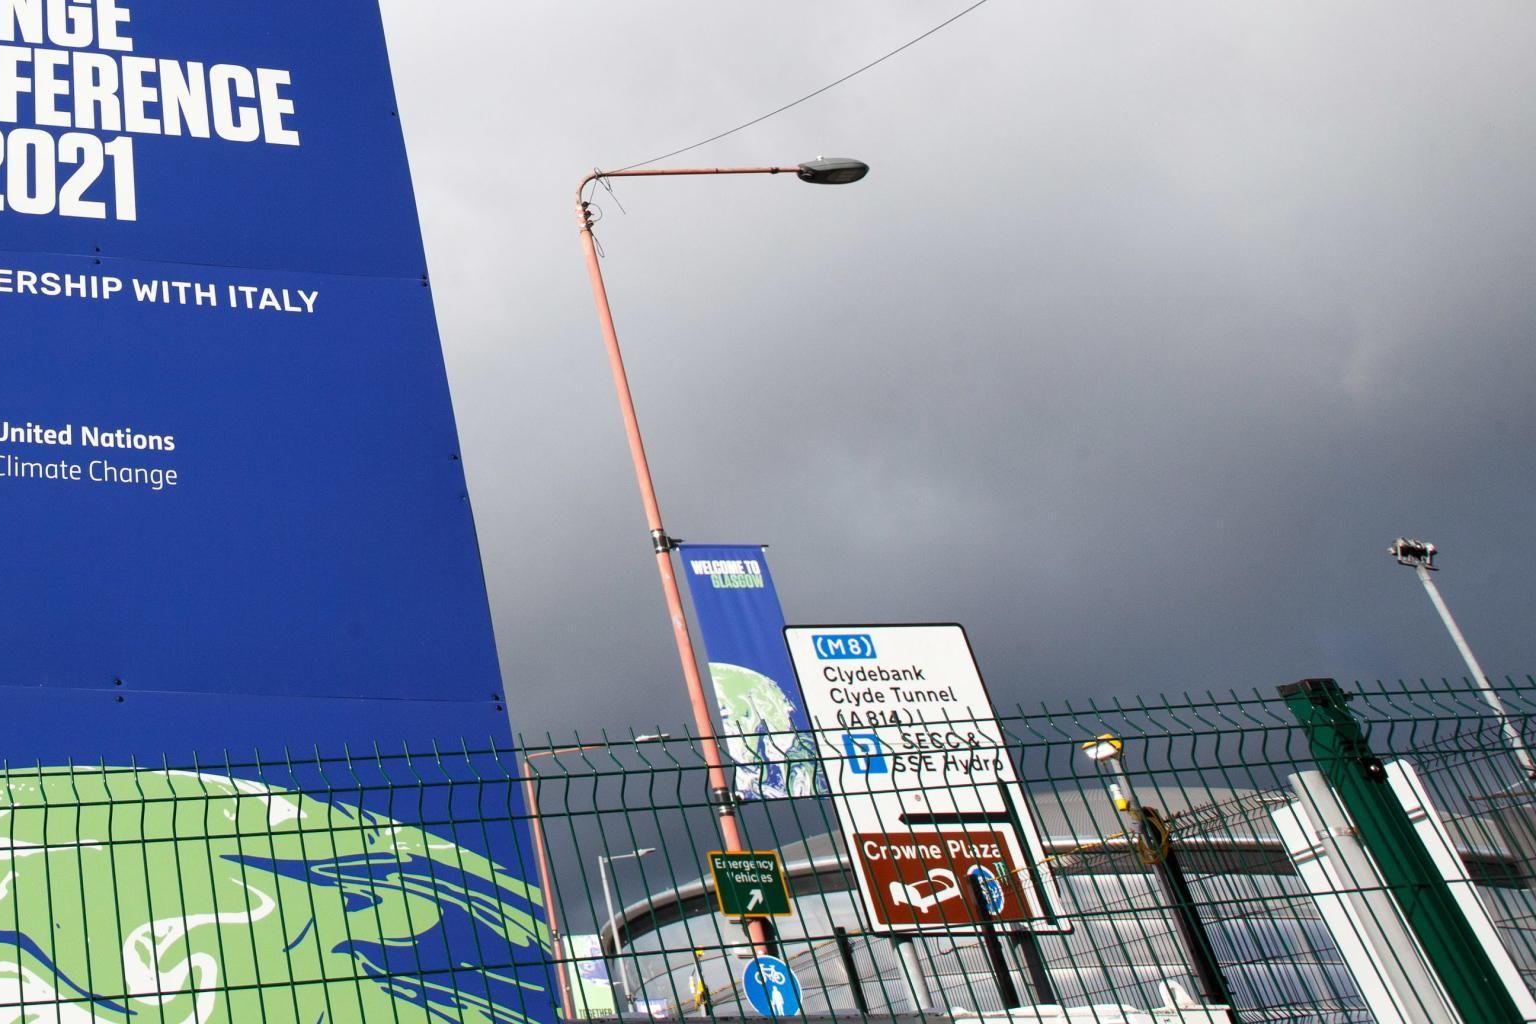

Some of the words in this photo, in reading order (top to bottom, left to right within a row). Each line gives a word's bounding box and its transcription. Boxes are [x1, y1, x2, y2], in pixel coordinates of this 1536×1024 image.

[133, 279, 217, 307] WITH
[229, 286, 319, 313] ITALY
[82, 426, 175, 451] Nations
[89, 460, 178, 491] Change
[690, 560, 745, 575] WELCOME
[744, 560, 761, 575] TO
[711, 574, 764, 589] GLASGOW
[816, 636, 873, 659] (M8)
[823, 665, 926, 685] Clydebank
[830, 687, 885, 707] Clyde
[890, 686, 958, 703] Tunnel
[837, 708, 914, 728] (A814)
[902, 732, 961, 750] SECC
[967, 731, 980, 747] &
[893, 754, 937, 773] SSE
[942, 753, 1004, 775] Hydro
[863, 840, 942, 860] Crowne
[946, 839, 1002, 859] Plaza
[714, 858, 774, 871] Emergency
